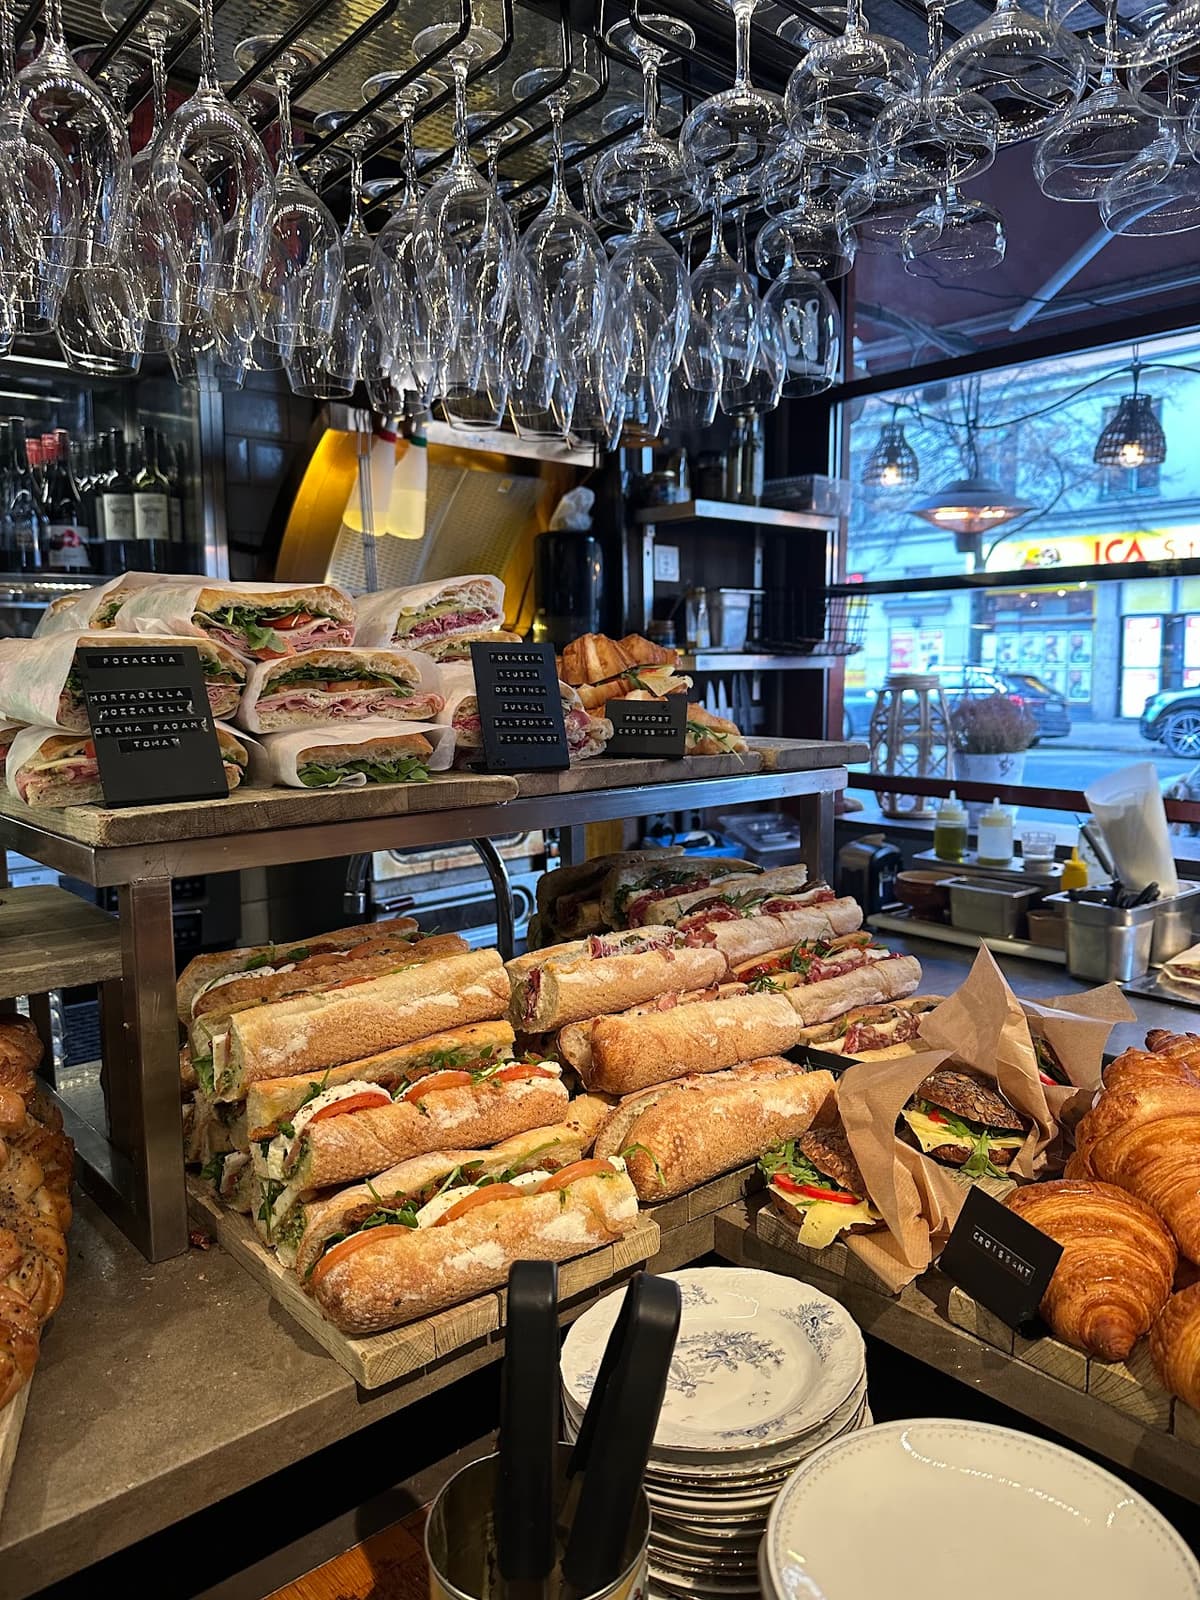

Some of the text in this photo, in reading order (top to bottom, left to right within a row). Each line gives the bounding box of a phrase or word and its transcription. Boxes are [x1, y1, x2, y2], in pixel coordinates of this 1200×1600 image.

[1095, 538, 1147, 564] ICA
[103, 656, 176, 664] FOCACCIA
[490, 654, 543, 662] FOCACCIA
[89, 690, 184, 702] MORTADELLA
[94, 725, 142, 735] GRANA
[973, 1231, 1031, 1277] CROISSANT
